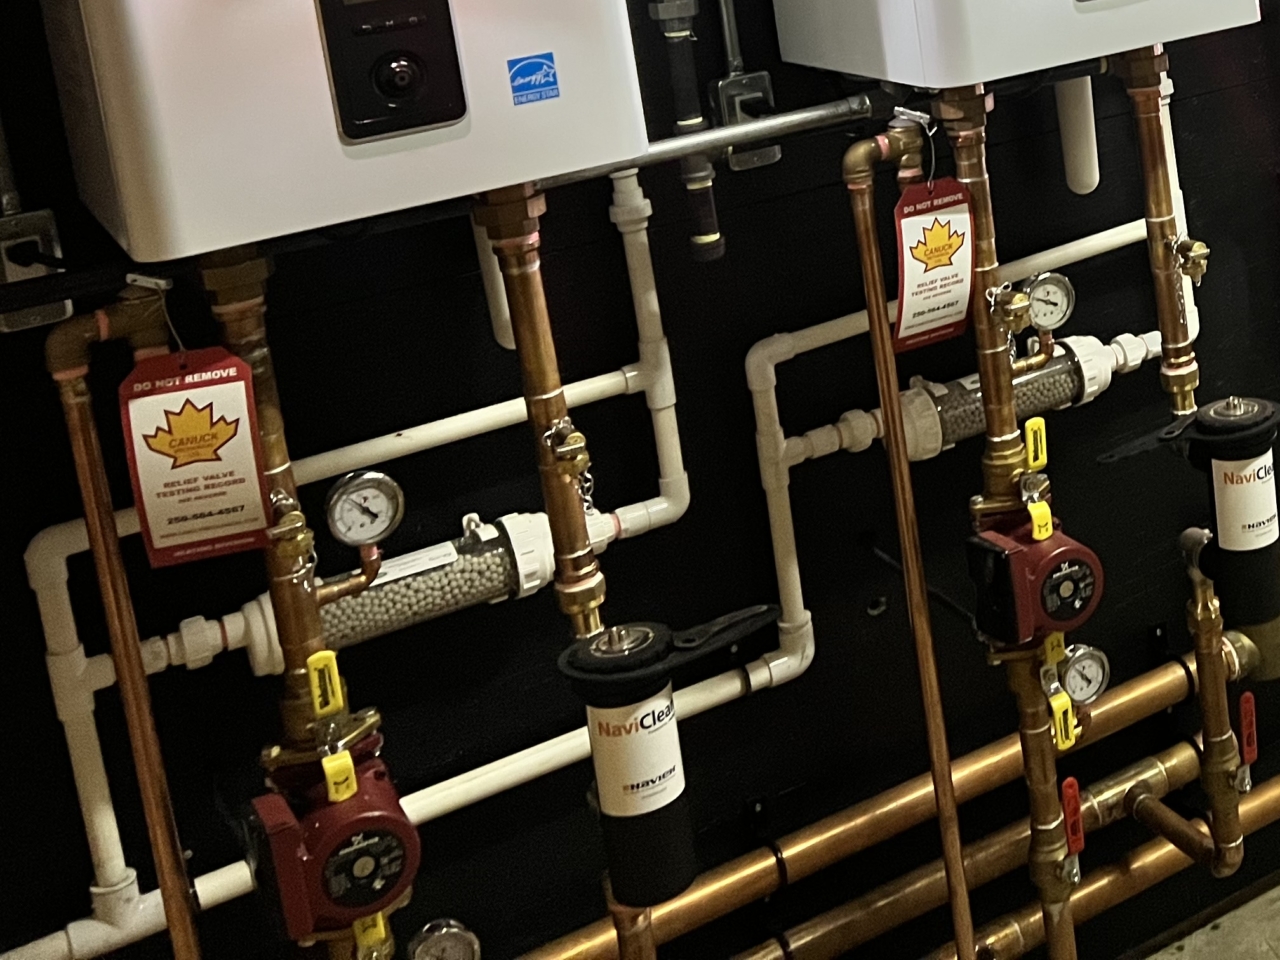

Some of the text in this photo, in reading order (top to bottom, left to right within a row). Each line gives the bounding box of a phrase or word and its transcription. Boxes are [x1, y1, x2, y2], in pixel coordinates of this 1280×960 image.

[903, 192, 963, 214] DO NOT REMOVE
[133, 367, 237, 392] DO NOT REMOVE
[168, 432, 218, 448] CANUCK
[163, 470, 235, 488] RELIEF VALVE
[1223, 462, 1274, 485] NaviCle
[155, 478, 246, 498] TESTING RECORD
